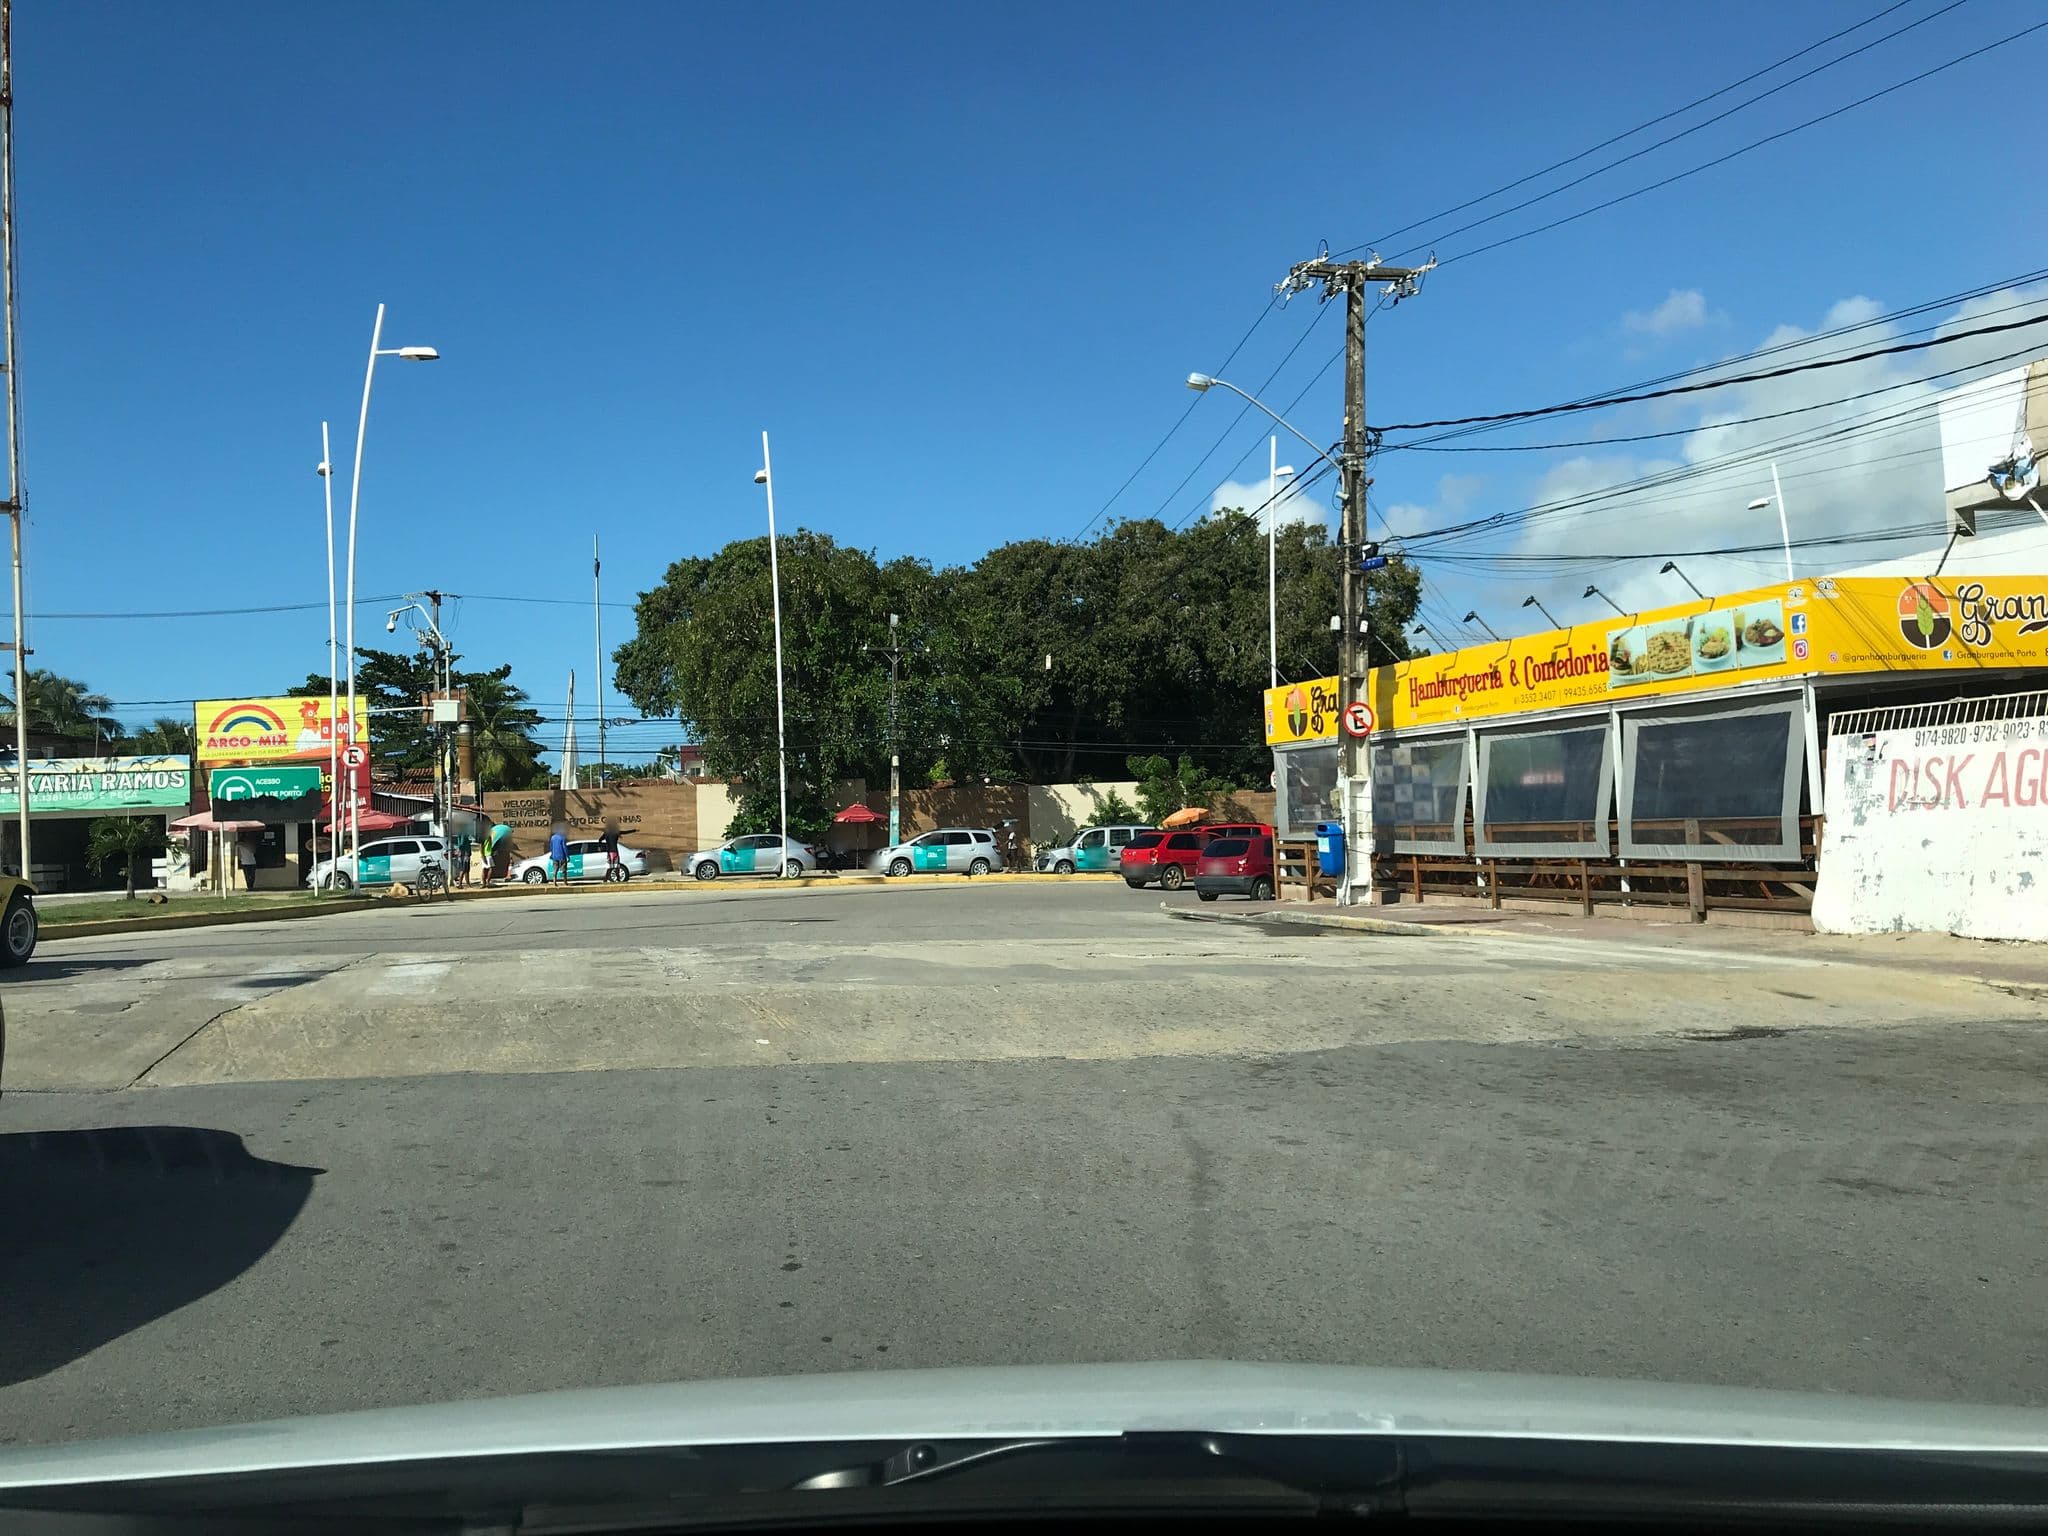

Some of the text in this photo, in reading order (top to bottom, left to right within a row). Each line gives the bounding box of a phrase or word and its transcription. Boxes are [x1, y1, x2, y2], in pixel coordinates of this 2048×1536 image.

[2016, 649, 2037, 659] Porto
[1409, 644, 1610, 708] Hamburgueria & Comedoria
[1311, 686, 1340, 735] Gra
[207, 734, 288, 748] ARCO-MIX
[1915, 727, 1967, 747] 9174-9820
[102, 770, 186, 790] RAMOS
[1888, 753, 1975, 812] DISK
[503, 799, 545, 808] WELCOME
